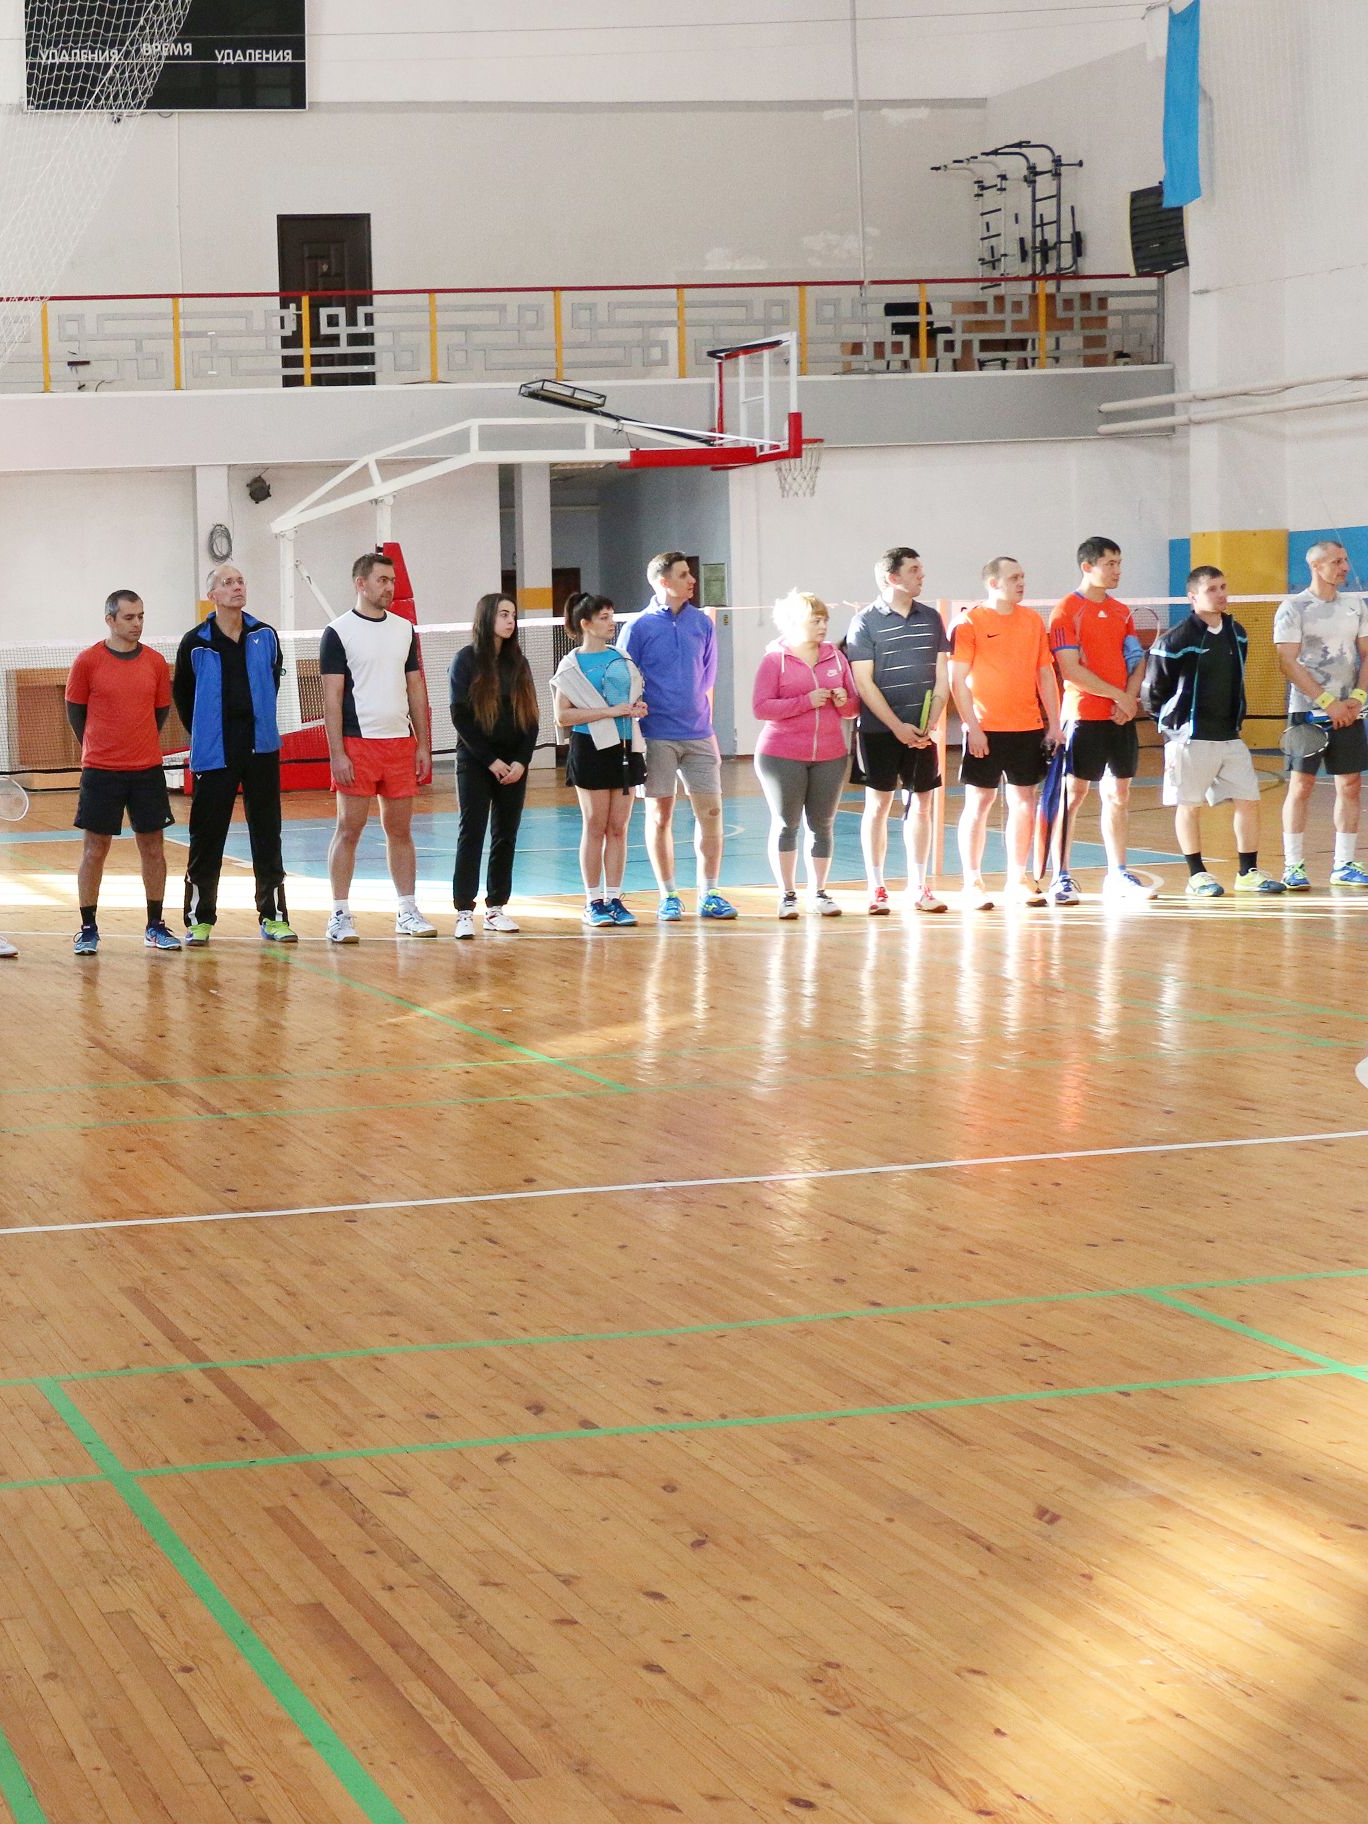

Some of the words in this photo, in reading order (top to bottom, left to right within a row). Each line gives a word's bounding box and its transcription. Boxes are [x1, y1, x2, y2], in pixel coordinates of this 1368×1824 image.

[142, 42, 193, 56] ВРЕМЯ
[39, 50, 119, 64] УДАЛЕНИЯ
[215, 49, 293, 64] УДАЛЕНИЯ
